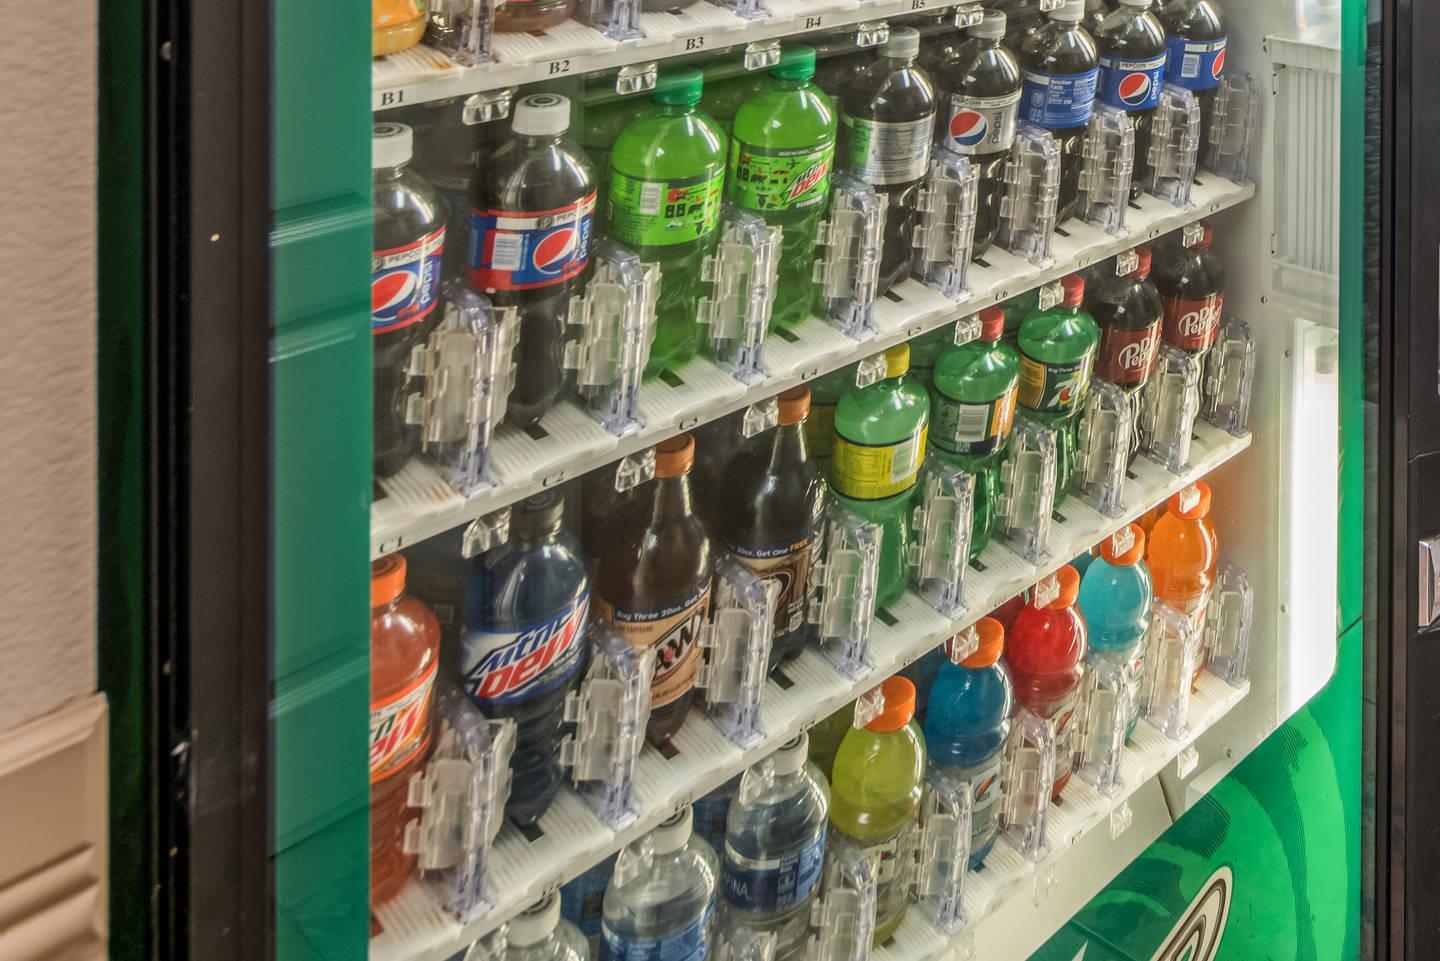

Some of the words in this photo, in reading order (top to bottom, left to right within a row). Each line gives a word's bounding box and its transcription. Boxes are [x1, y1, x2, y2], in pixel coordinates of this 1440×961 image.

[805, 16, 821, 29] B4
[685, 36, 704, 51] B3
[548, 60, 570, 75] B2
[1150, 71, 1160, 101] pepsi
[381, 91, 405, 106] B1
[991, 111, 1003, 144] pepsi
[665, 203, 686, 219] 88
[580, 218, 591, 259] pepsi
[421, 259, 433, 304] pepsi
[634, 612, 658, 620] Three
[661, 606, 684, 617] 20oz.
[684, 597, 698, 607] Get
